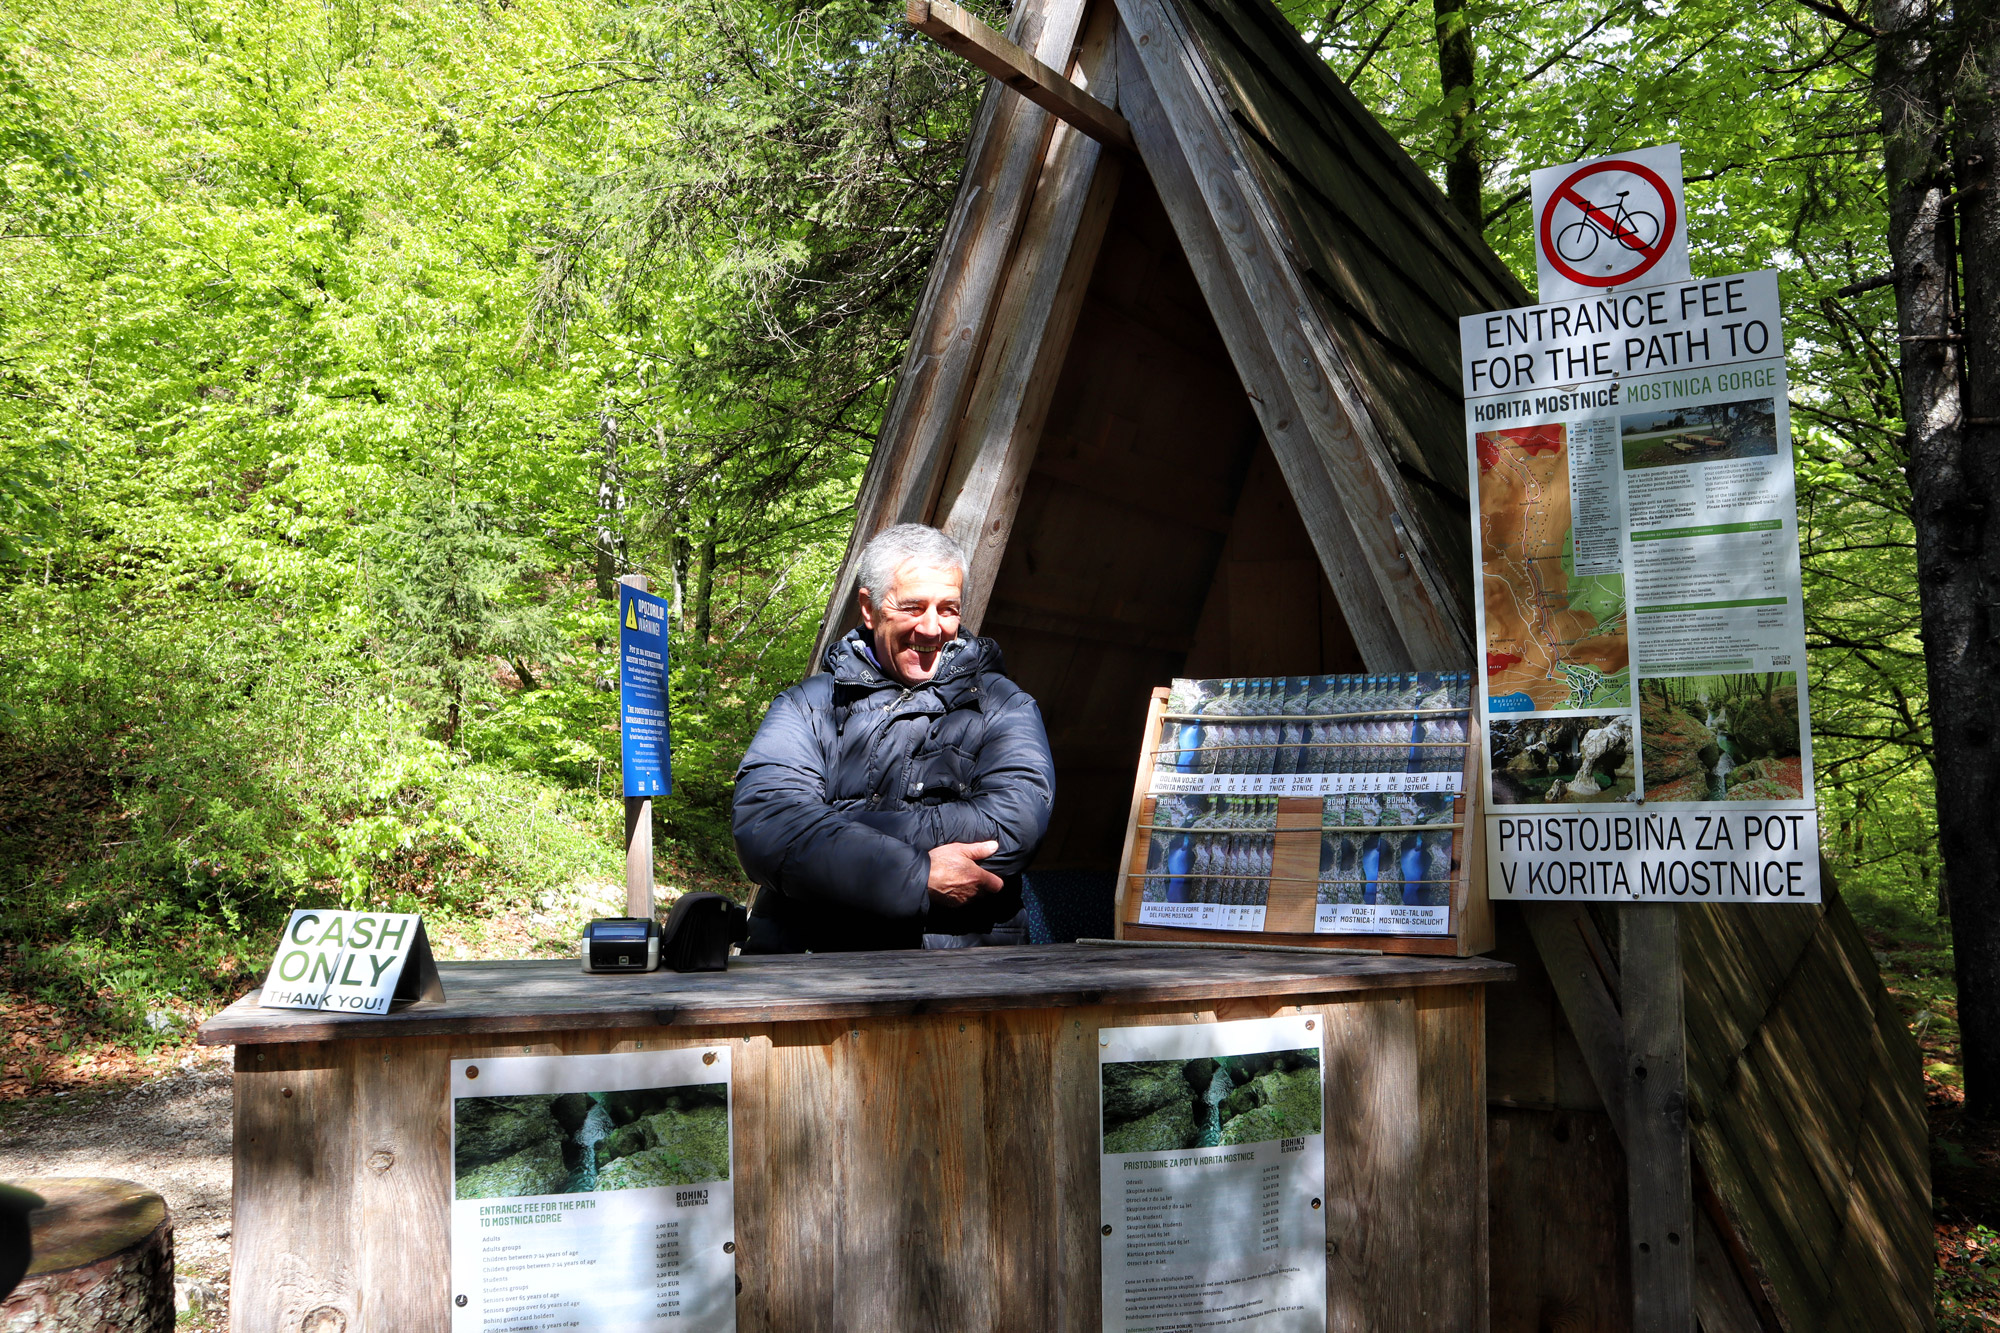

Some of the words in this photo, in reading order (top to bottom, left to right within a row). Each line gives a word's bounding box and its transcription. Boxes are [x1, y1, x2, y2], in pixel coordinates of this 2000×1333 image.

[1486, 291, 1667, 348] ENTRANCE
[1680, 279, 1747, 320] FEE
[1471, 353, 1534, 391] FOR
[1545, 342, 1612, 380] THE
[1625, 328, 1710, 370] PATH
[1722, 320, 1768, 356] TO
[1627, 376, 1712, 403] MOSTNICA
[1718, 368, 1776, 391] GORGE
[1475, 400, 1531, 422] KORITA
[1536, 389, 1619, 414] MOSTNICE
[1500, 817, 1686, 851] PRISTOJBINA
[1695, 816, 1733, 850] ZA
[1745, 816, 1804, 850] POT
[1501, 862, 1517, 894] V
[1529, 861, 1631, 895] KORITA
[1641, 861, 1805, 896] MOSTNICE
[1379, 917, 1443, 925] MOSTNICA-SCHLUCHT
[291, 914, 409, 950] CASH
[279, 950, 397, 987] ONLY
[270, 991, 333, 1007] THANK
[339, 995, 384, 1010] YOU!
[1281, 1137, 1305, 1147] BOHINJ
[1281, 1145, 1304, 1154] SLOVENIJA
[1124, 1160, 1168, 1170] PRISTOJBINE
[1170, 1159, 1178, 1167] ZA
[1180, 1158, 1192, 1166] POT
[1200, 1156, 1222, 1165] KORITA
[1224, 1152, 1254, 1163] MOSTNICE
[677, 1190, 708, 1200] BOHINJ
[677, 1199, 708, 1207] SLOVENIJA
[480, 1204, 522, 1215] ENTRANCE
[525, 1203, 539, 1213] FEE
[541, 1202, 557, 1212] FOR
[559, 1201, 574, 1210] THE
[576, 1200, 596, 1209] PATH
[480, 1218, 490, 1227] TO
[493, 1215, 533, 1226] MOSTNICA
[535, 1214, 562, 1223] GORGE
[506, 1264, 525, 1272] groups
